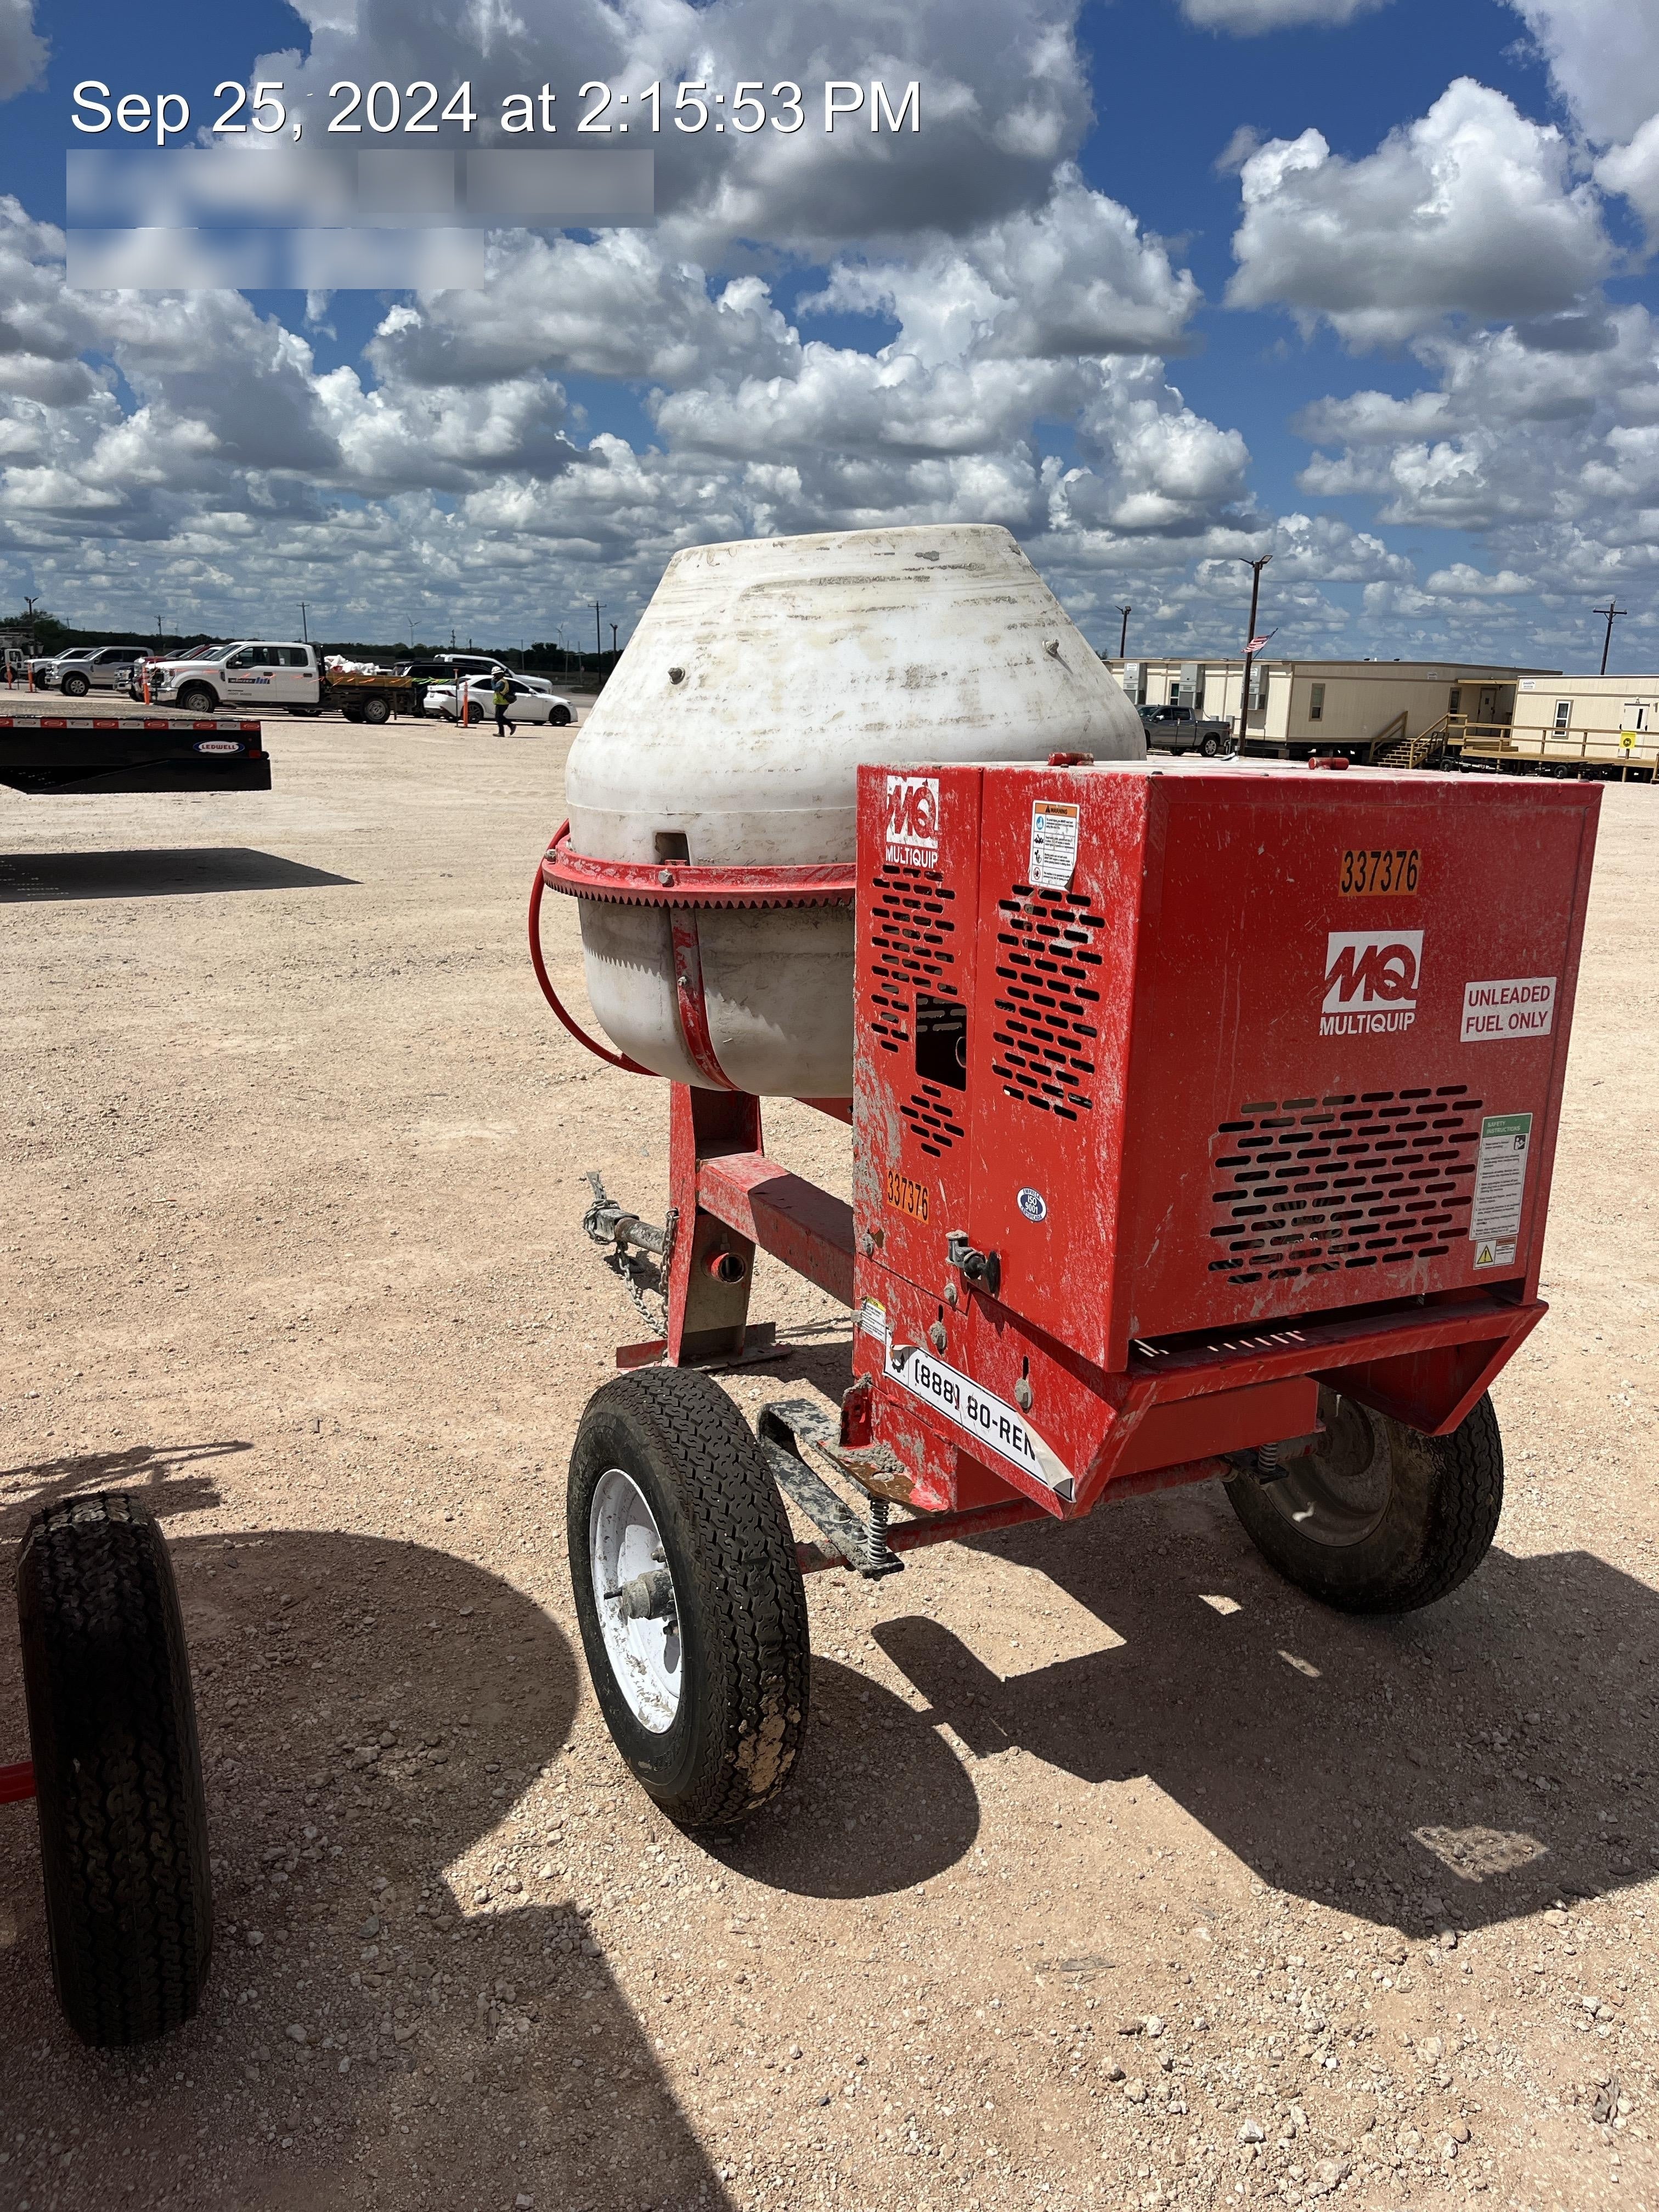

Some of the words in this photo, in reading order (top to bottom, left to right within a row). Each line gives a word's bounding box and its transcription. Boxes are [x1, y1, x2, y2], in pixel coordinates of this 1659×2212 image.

[887, 785, 938, 839] MQ
[885, 845, 939, 869] MULTIQUIP
[1342, 850, 1419, 893] 337376
[1324, 944, 1417, 1002] MQ
[1469, 985, 1550, 1007] UNLEADED
[1319, 1012, 1415, 1036] MULTIQUIP
[1466, 1015, 1504, 1034] FUEL
[1509, 1011, 1549, 1030] ONLY
[888, 1170, 928, 1221] 337376
[1028, 1195, 1037, 1206] ISO
[1025, 1201, 1039, 1215] 9001
